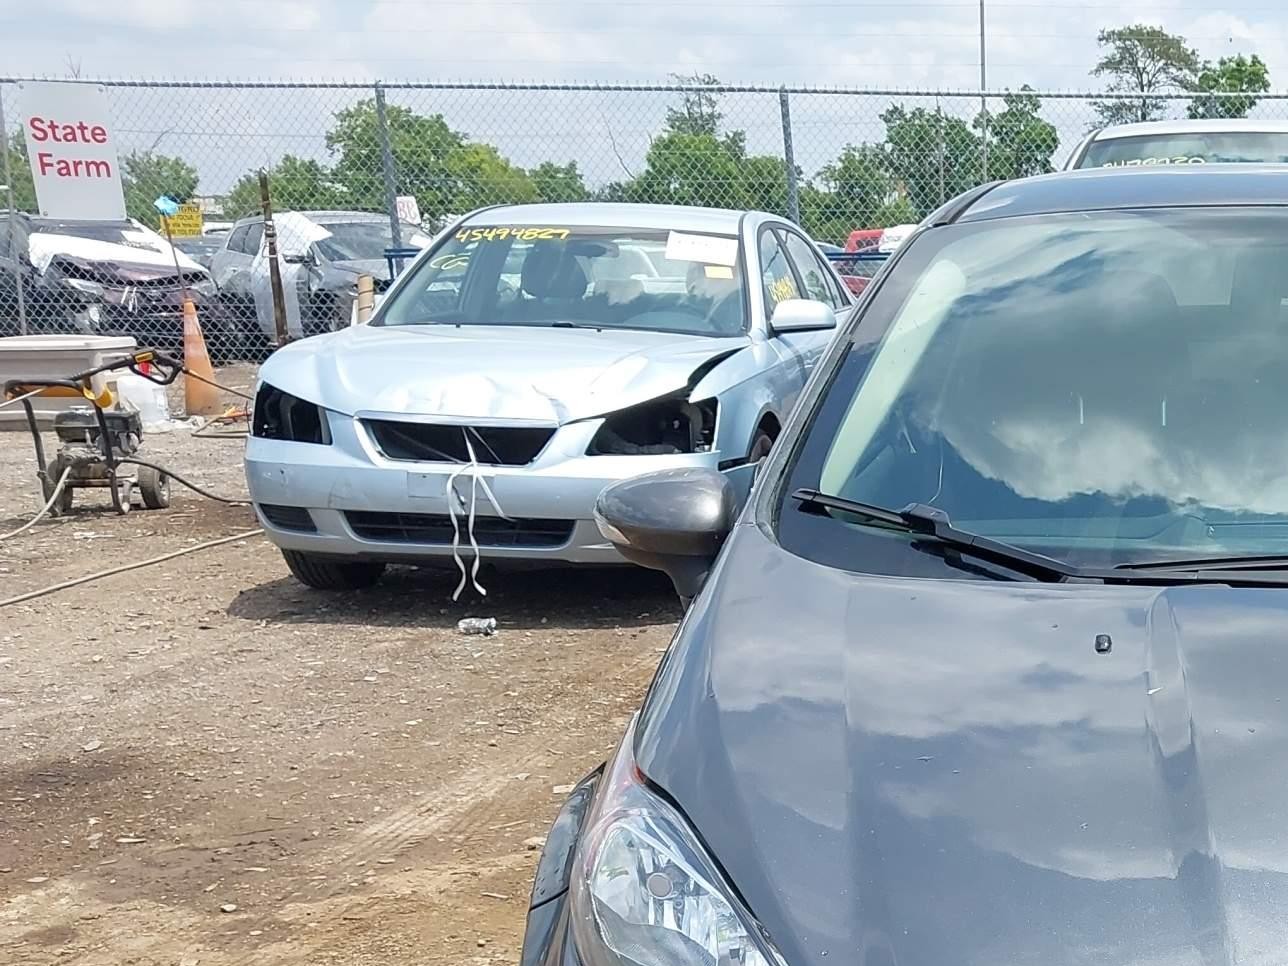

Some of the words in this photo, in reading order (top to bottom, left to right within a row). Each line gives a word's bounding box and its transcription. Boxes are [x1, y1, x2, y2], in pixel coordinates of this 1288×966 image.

[29, 117, 108, 144] State
[38, 152, 112, 178] Farm
[455, 228, 571, 243] 45494827
